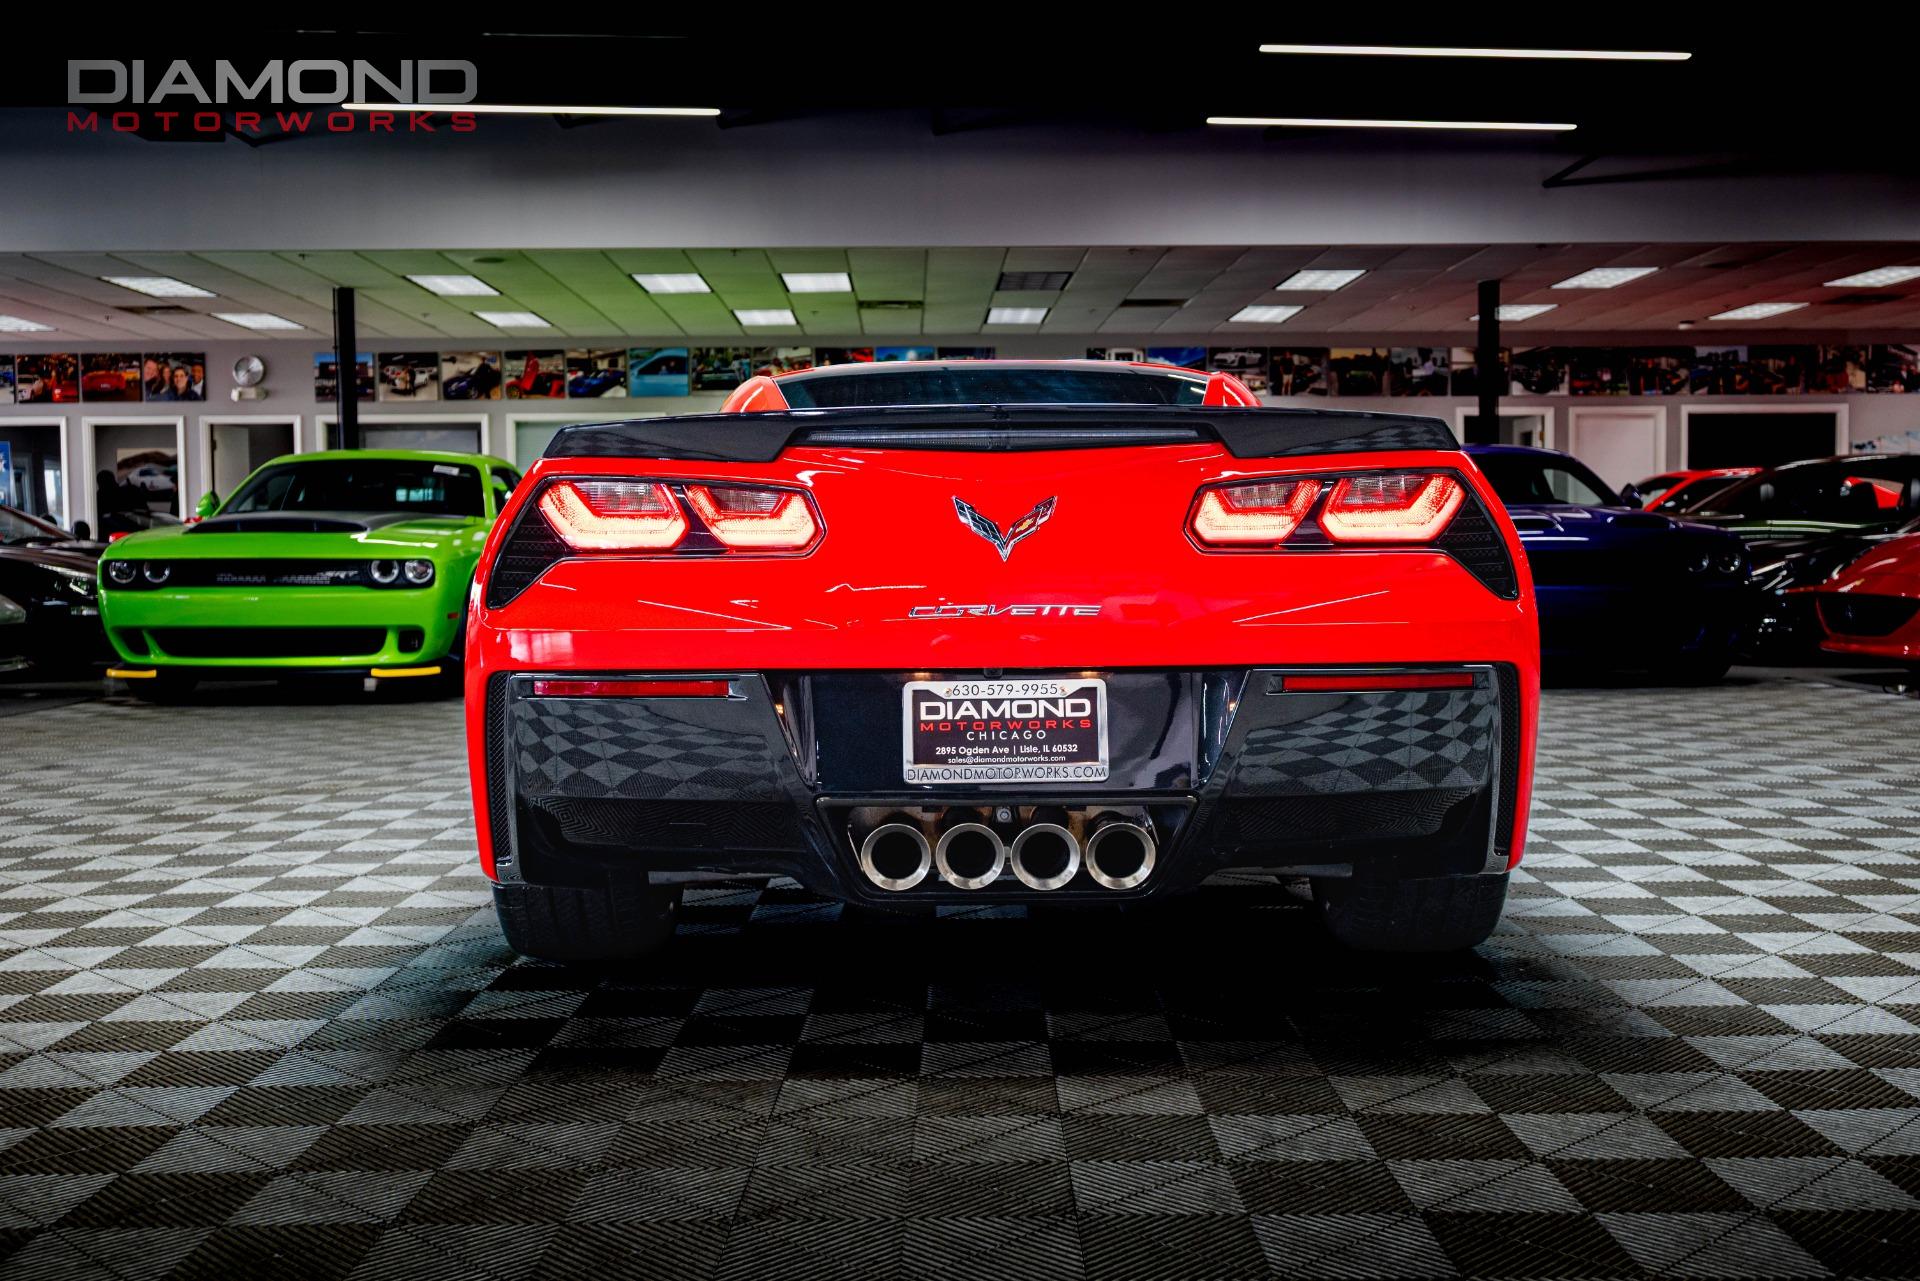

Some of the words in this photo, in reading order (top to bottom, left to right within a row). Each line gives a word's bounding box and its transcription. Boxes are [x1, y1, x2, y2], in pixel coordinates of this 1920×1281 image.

[908, 604, 1102, 618] CORVETTE
[952, 683, 1058, 697] 630-579-9955
[919, 698, 1091, 720] DIAMOND
[920, 720, 1092, 732] MOTORWORKS
[966, 730, 1046, 741] CHICAGO
[935, 746, 957, 755] 2895
[958, 746, 990, 756] Ogden
[991, 746, 1010, 754] Ave
[1020, 744, 1041, 754] Lisle,
[1043, 744, 1050, 753] IL
[1052, 744, 1078, 753] 60532
[947, 755, 1066, 764] sales@diamondmotorworks.com
[907, 766, 1107, 781] DIAMONDMOTORWORKS.COM
